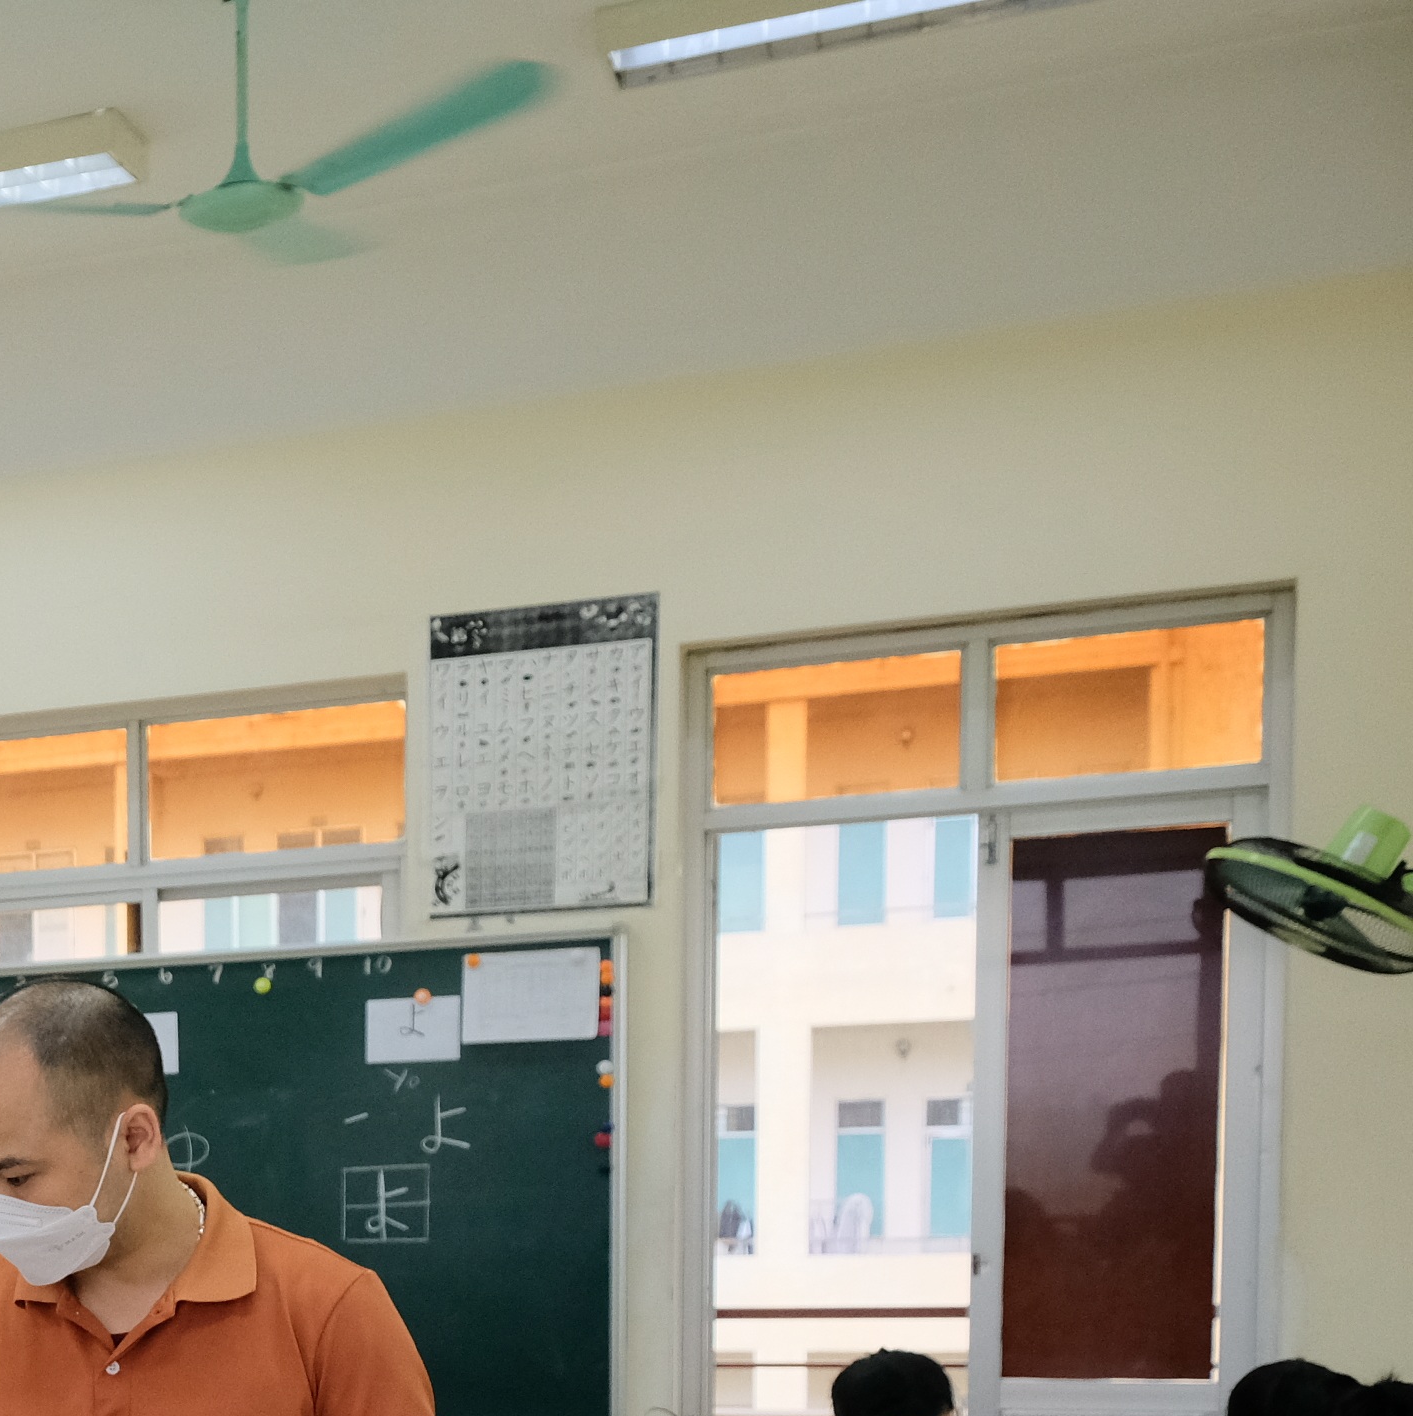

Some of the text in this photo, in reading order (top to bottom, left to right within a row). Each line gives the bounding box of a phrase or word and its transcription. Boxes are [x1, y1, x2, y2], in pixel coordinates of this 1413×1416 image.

[157, 968, 174, 985] 6
[210, 963, 225, 985] 7
[363, 956, 392, 976] 10
[102, 972, 119, 989] 5
[399, 1003, 425, 1037] よ
[420, 1094, 471, 1153] よ
[365, 1168, 410, 1242] よ
